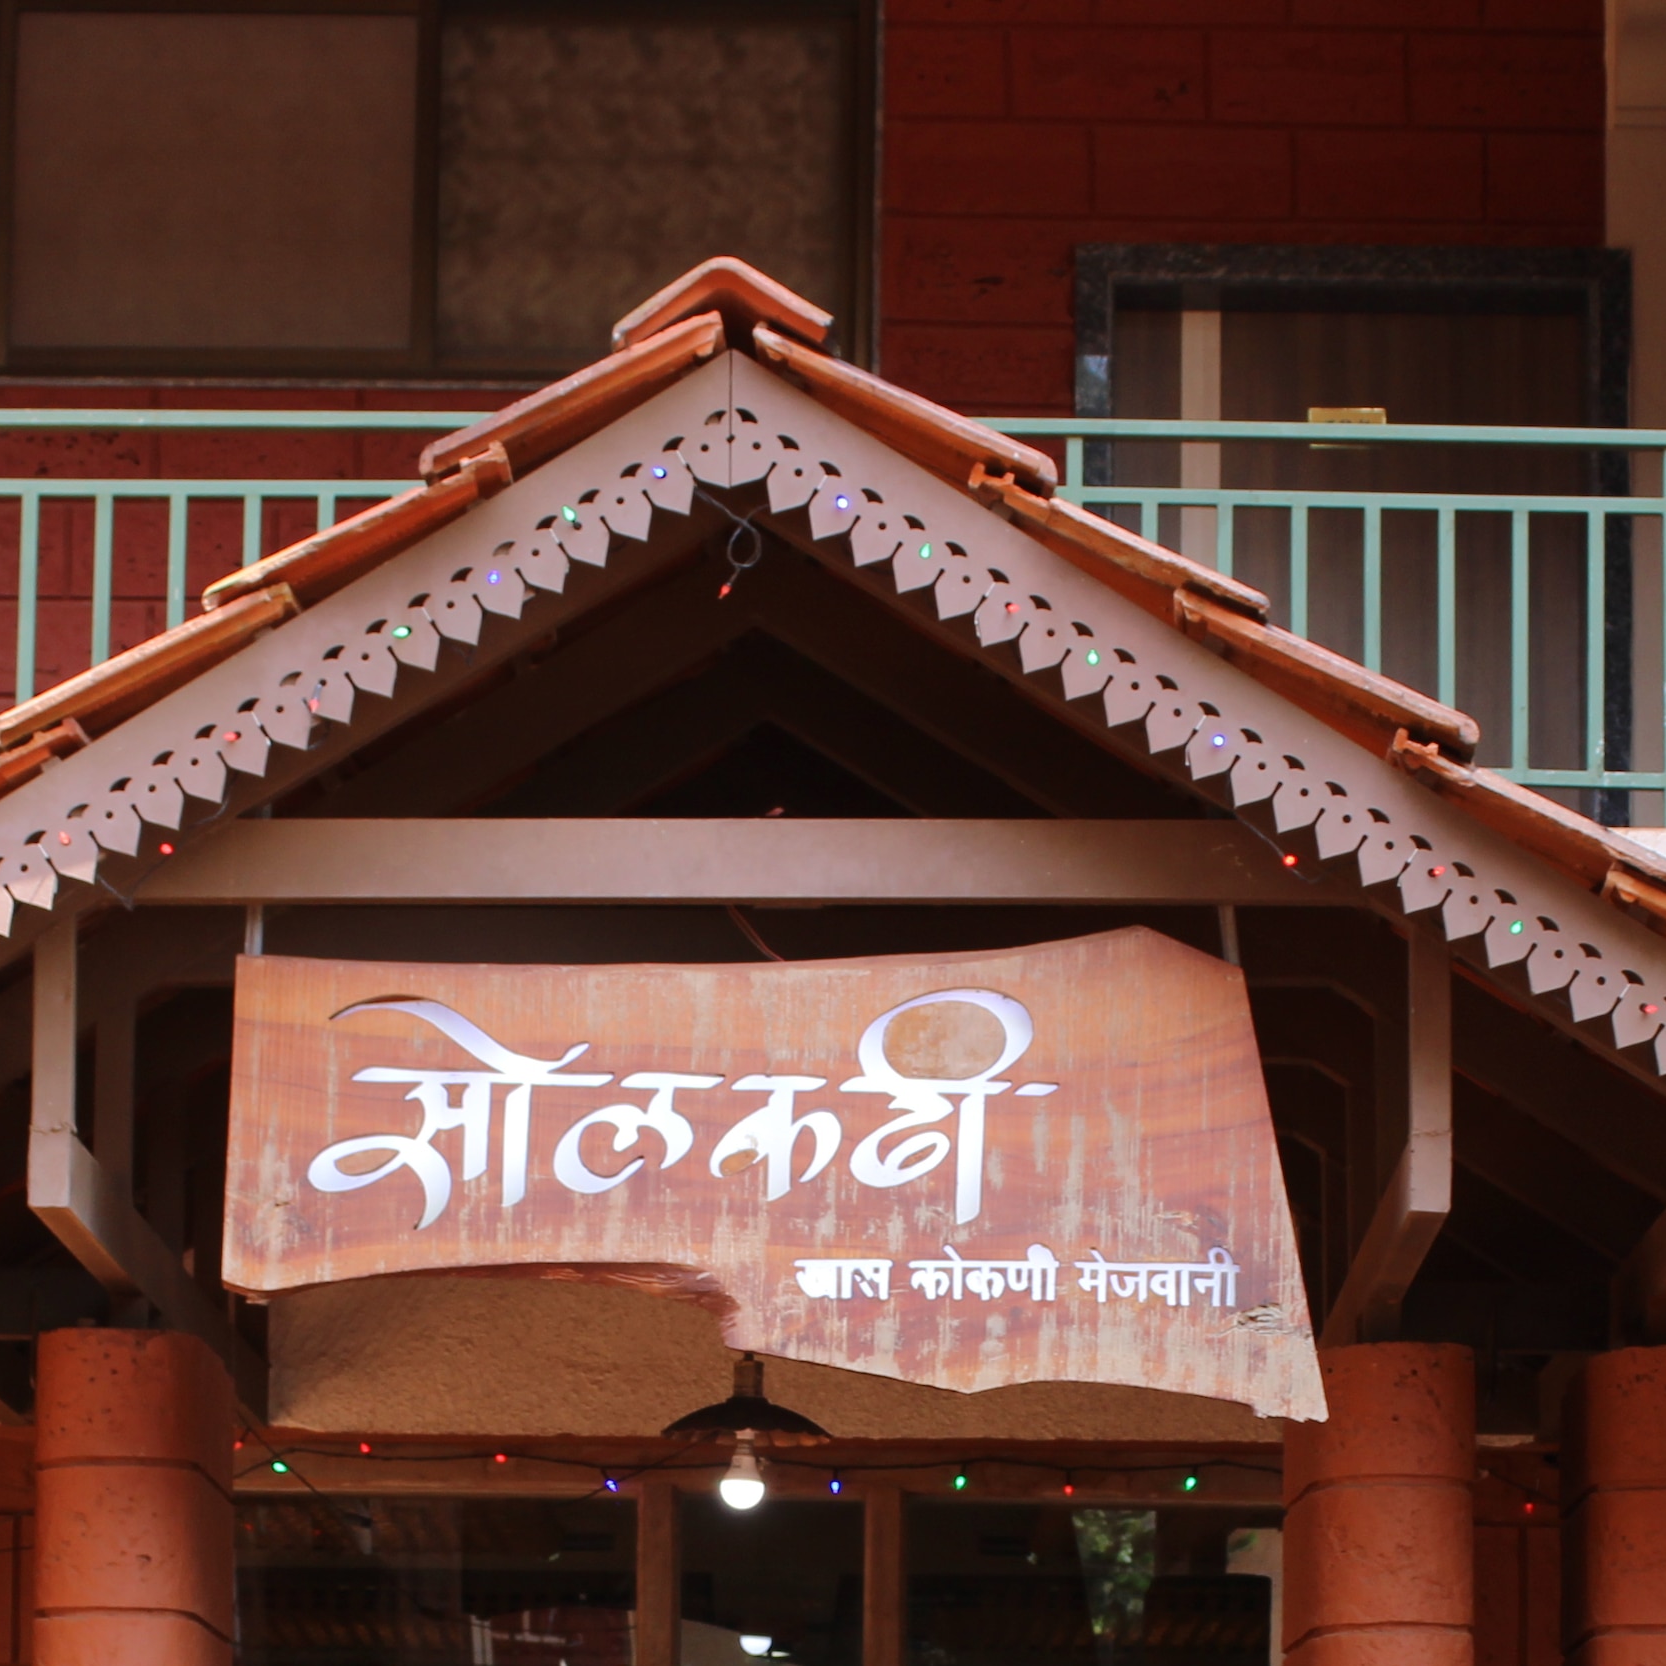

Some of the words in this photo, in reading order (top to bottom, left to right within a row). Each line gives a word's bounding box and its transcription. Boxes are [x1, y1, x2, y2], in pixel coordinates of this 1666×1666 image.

[307, 989, 1060, 1230] सोलकढी
[793, 1258, 893, 1300] खास
[908, 1243, 1060, 1301] कोकणी
[1073, 1246, 1241, 1307] मेजवानी
